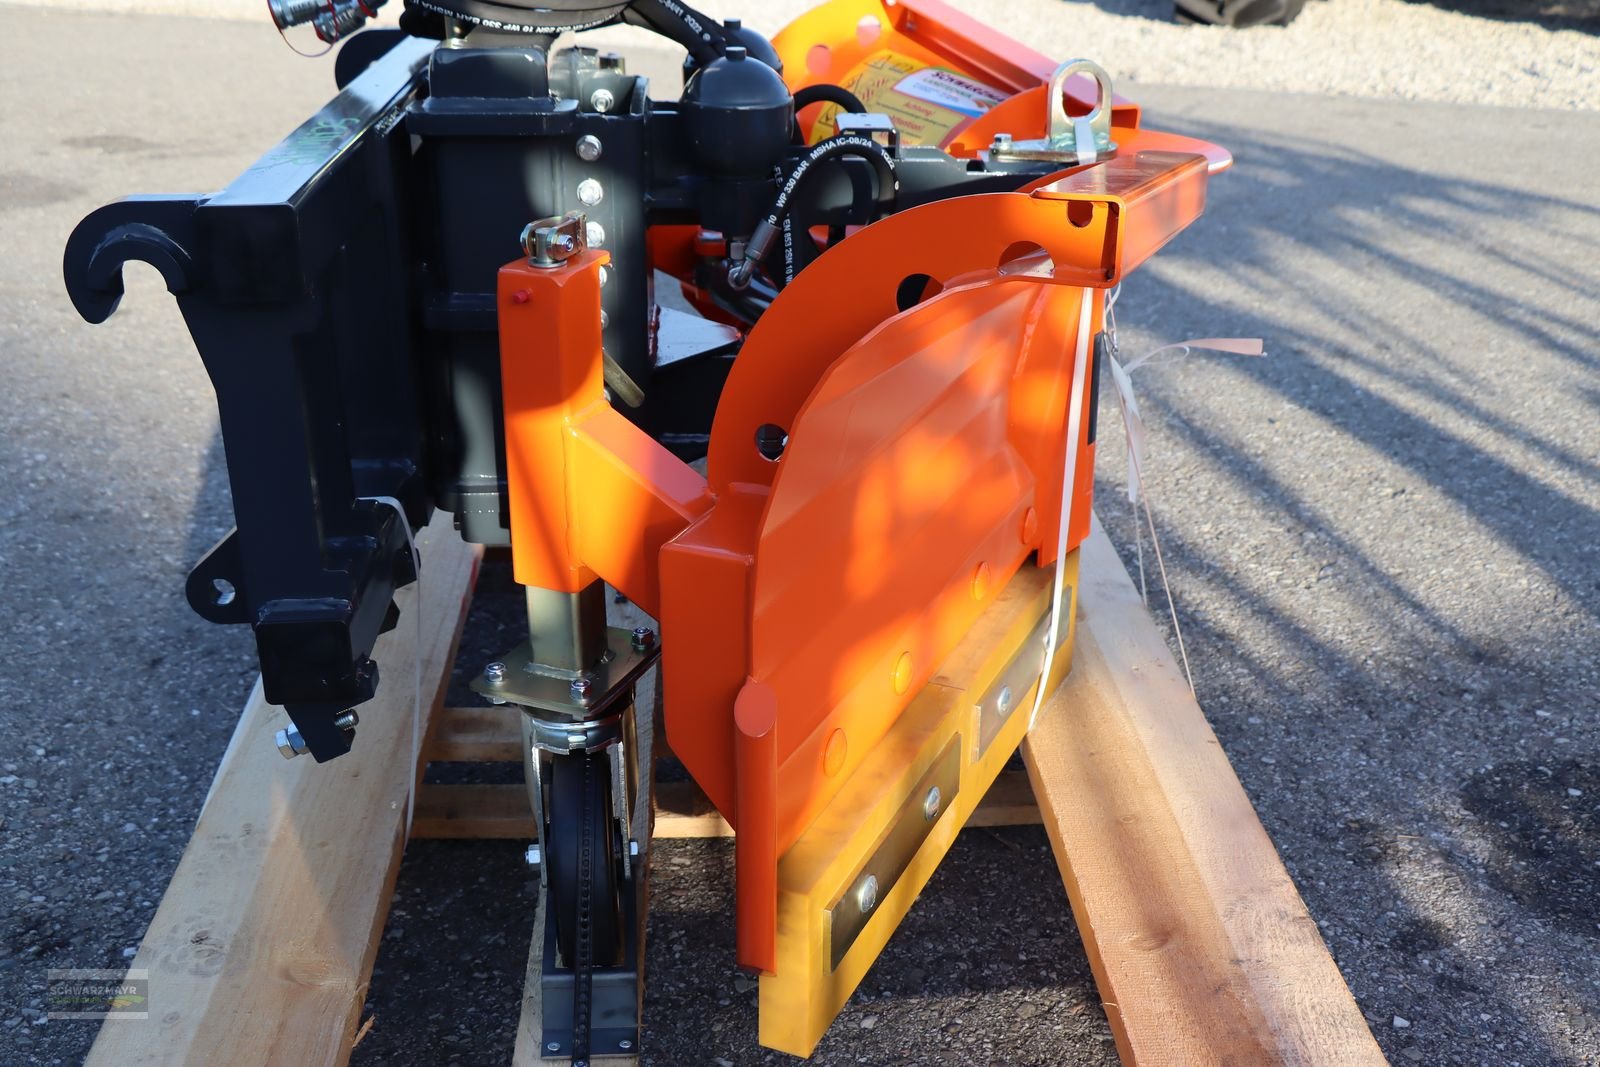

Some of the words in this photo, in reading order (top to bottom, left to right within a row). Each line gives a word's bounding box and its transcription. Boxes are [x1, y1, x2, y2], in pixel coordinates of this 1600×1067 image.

[482, 19, 502, 28] 330
[503, 22, 521, 31] WP
[768, 214, 777, 225] 10
[775, 192, 787, 208] WP
[784, 177, 797, 194] 330
[792, 160, 810, 180] BAR
[810, 141, 837, 160] MSHA
[836, 136, 872, 148] IC-08/24
[783, 218, 791, 232] EN
[784, 232, 792, 247] 853
[785, 247, 793, 264] 2SN
[785, 265, 793, 275] 10
